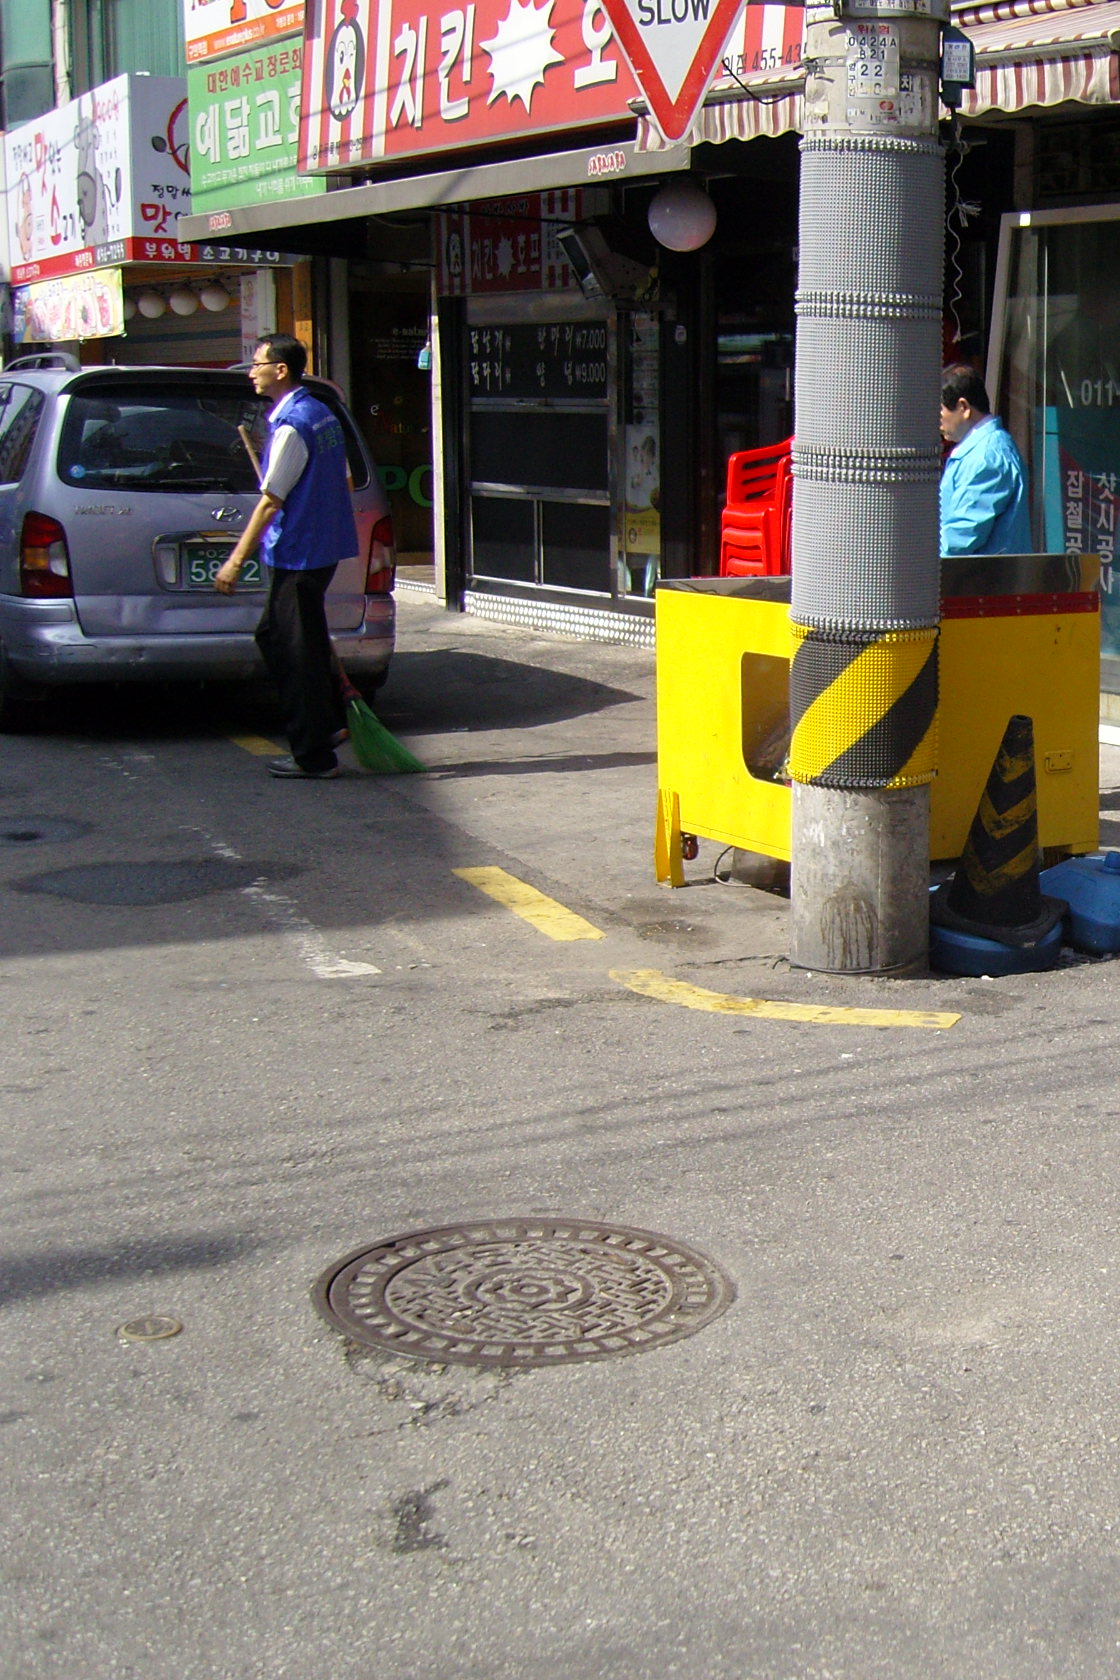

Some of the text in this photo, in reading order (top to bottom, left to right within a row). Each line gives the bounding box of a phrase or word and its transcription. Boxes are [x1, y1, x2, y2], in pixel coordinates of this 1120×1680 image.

[638, 0, 710, 26] SLOW
[207, 48, 302, 93] 대한예수교장로회
[390, 0, 618, 128] 치킨 호
[722, 42, 807, 77] 인점 455-43
[860, 64, 883, 77] 22
[146, 242, 191, 260] 부위별
[472, 238, 494, 281] 치킨
[516, 231, 541, 274] 호프
[1065, 470, 1084, 555] 잡철공
[1096, 473, 1117, 595] 샷시공사
[190, 560, 260, 582] 582
[206, 549, 229, 558] 02
